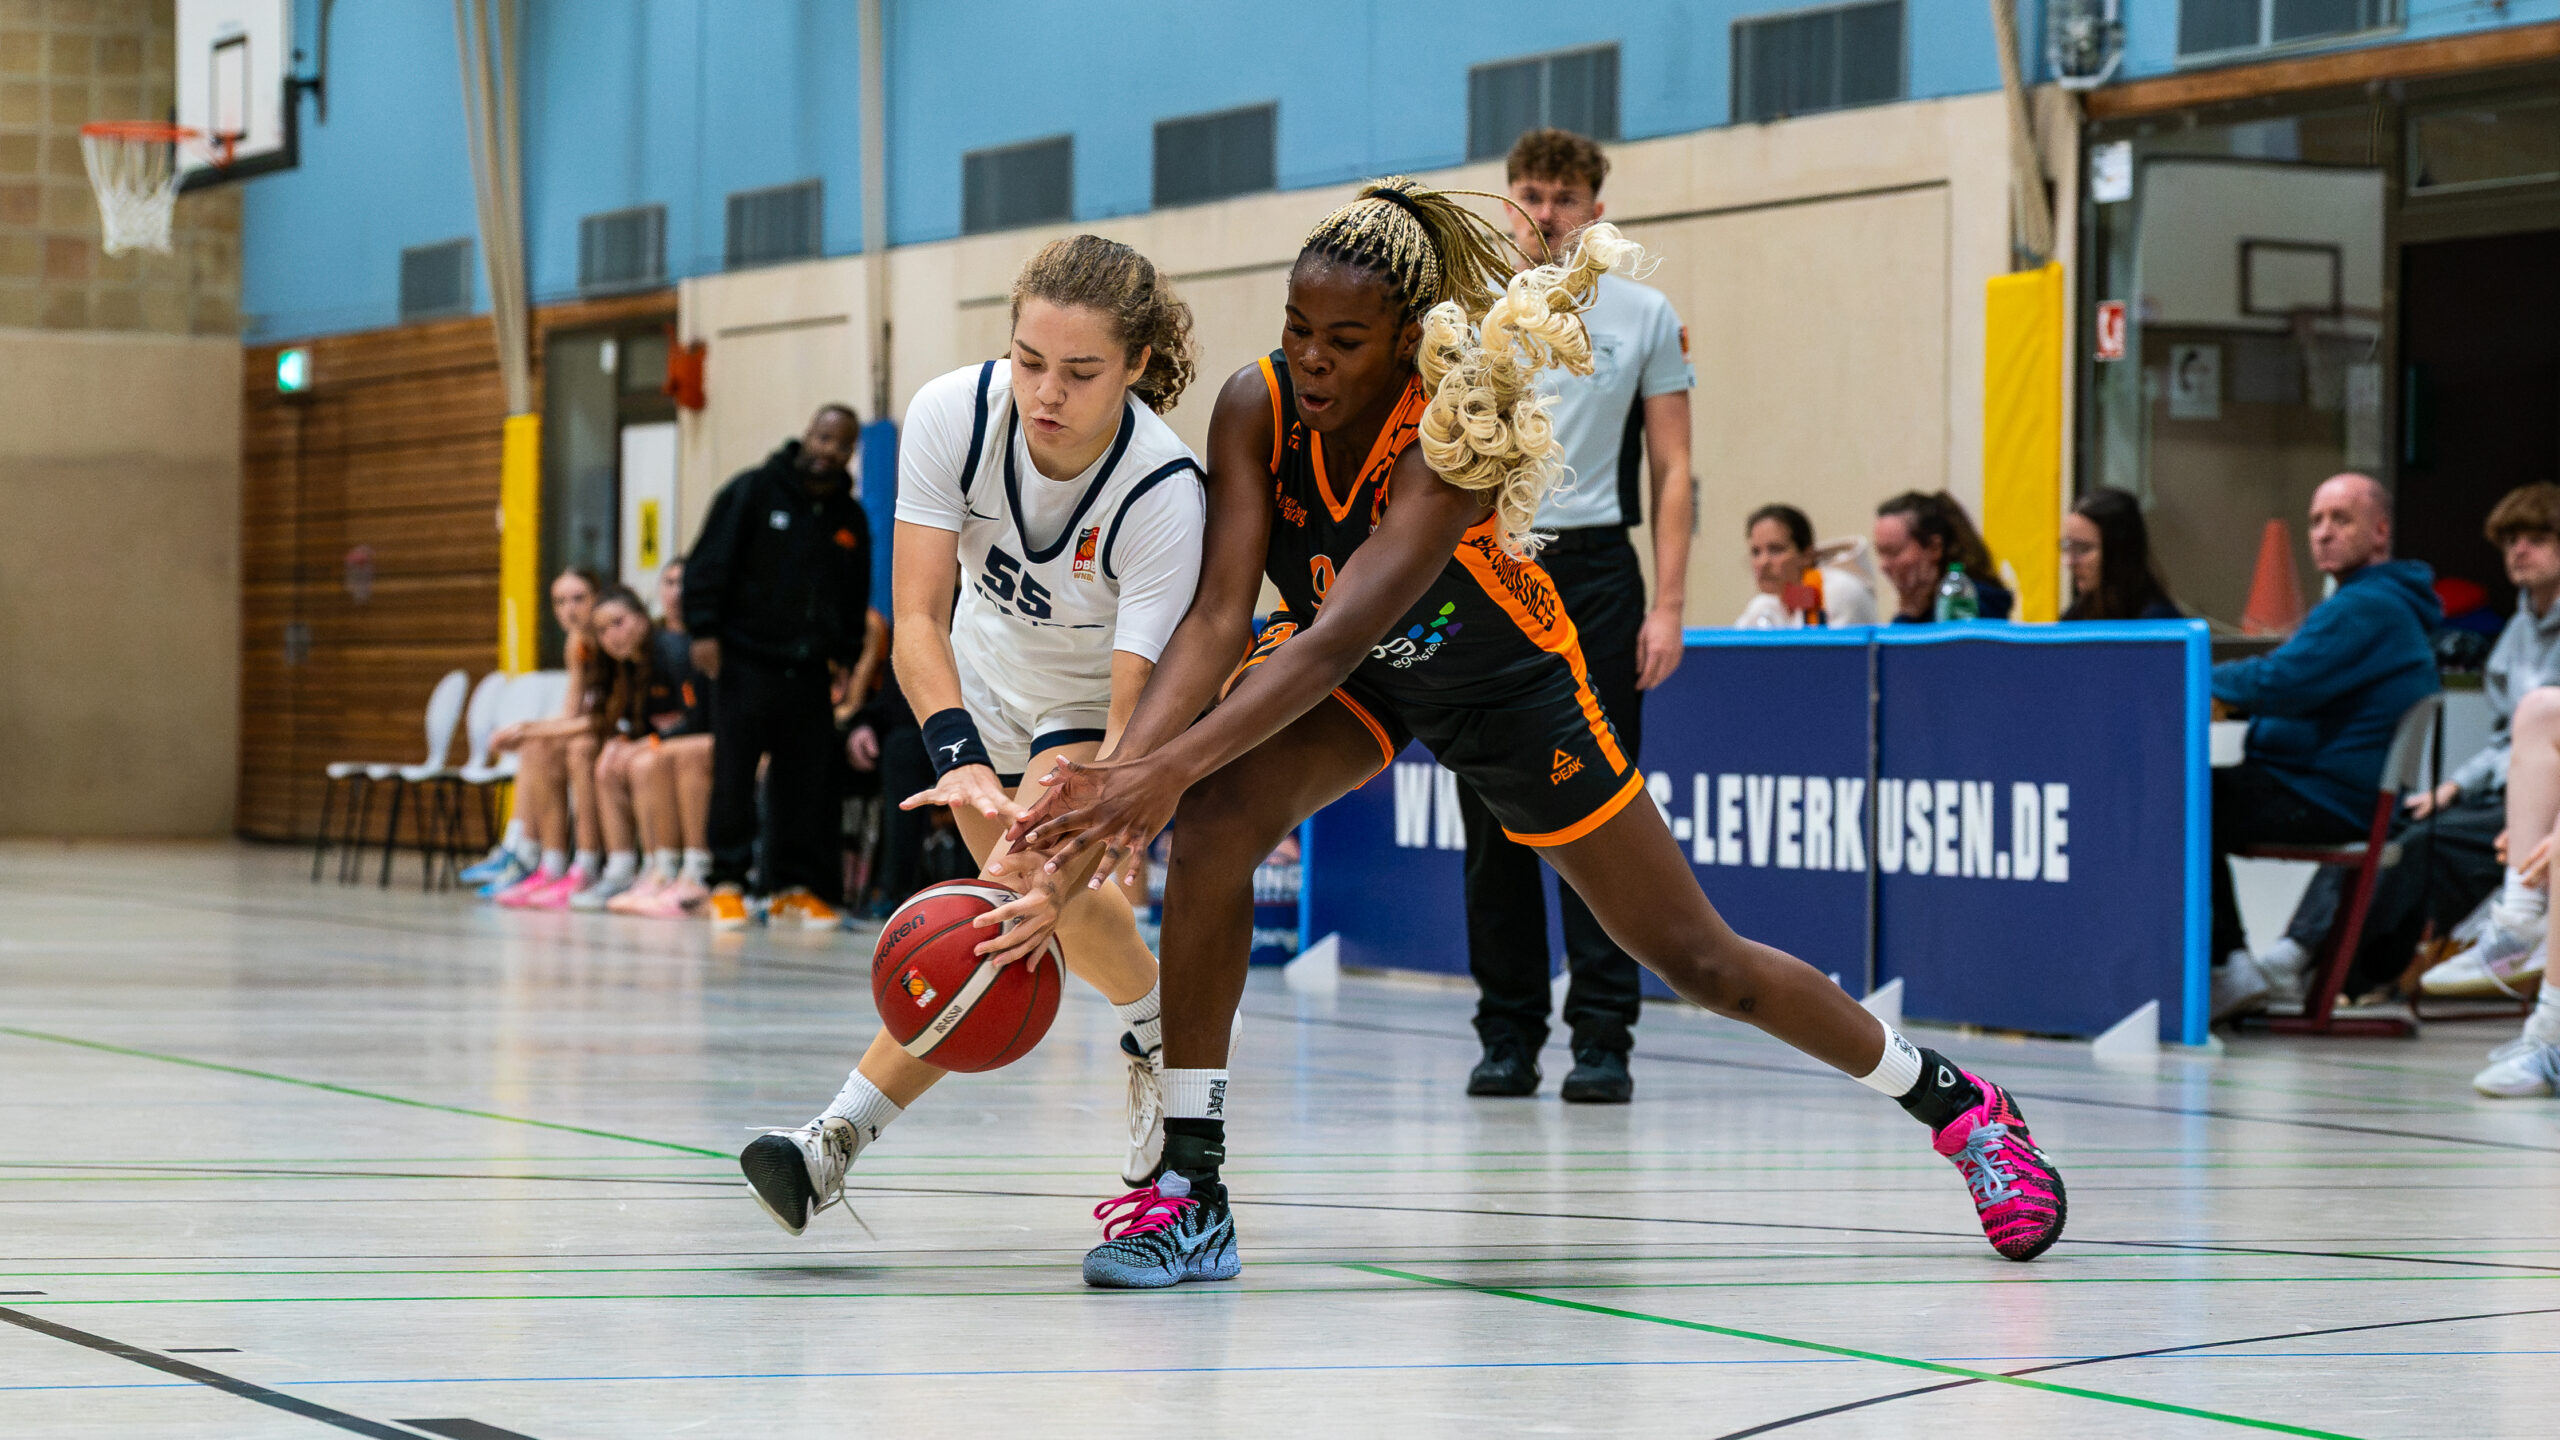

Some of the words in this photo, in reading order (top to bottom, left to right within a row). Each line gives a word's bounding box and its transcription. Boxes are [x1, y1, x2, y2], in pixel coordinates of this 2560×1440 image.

[981, 544, 1052, 620] 55
[1550, 757, 1585, 785] PEAK
[873, 913, 926, 977] molten
[1206, 1079, 1228, 1118] PEAK
